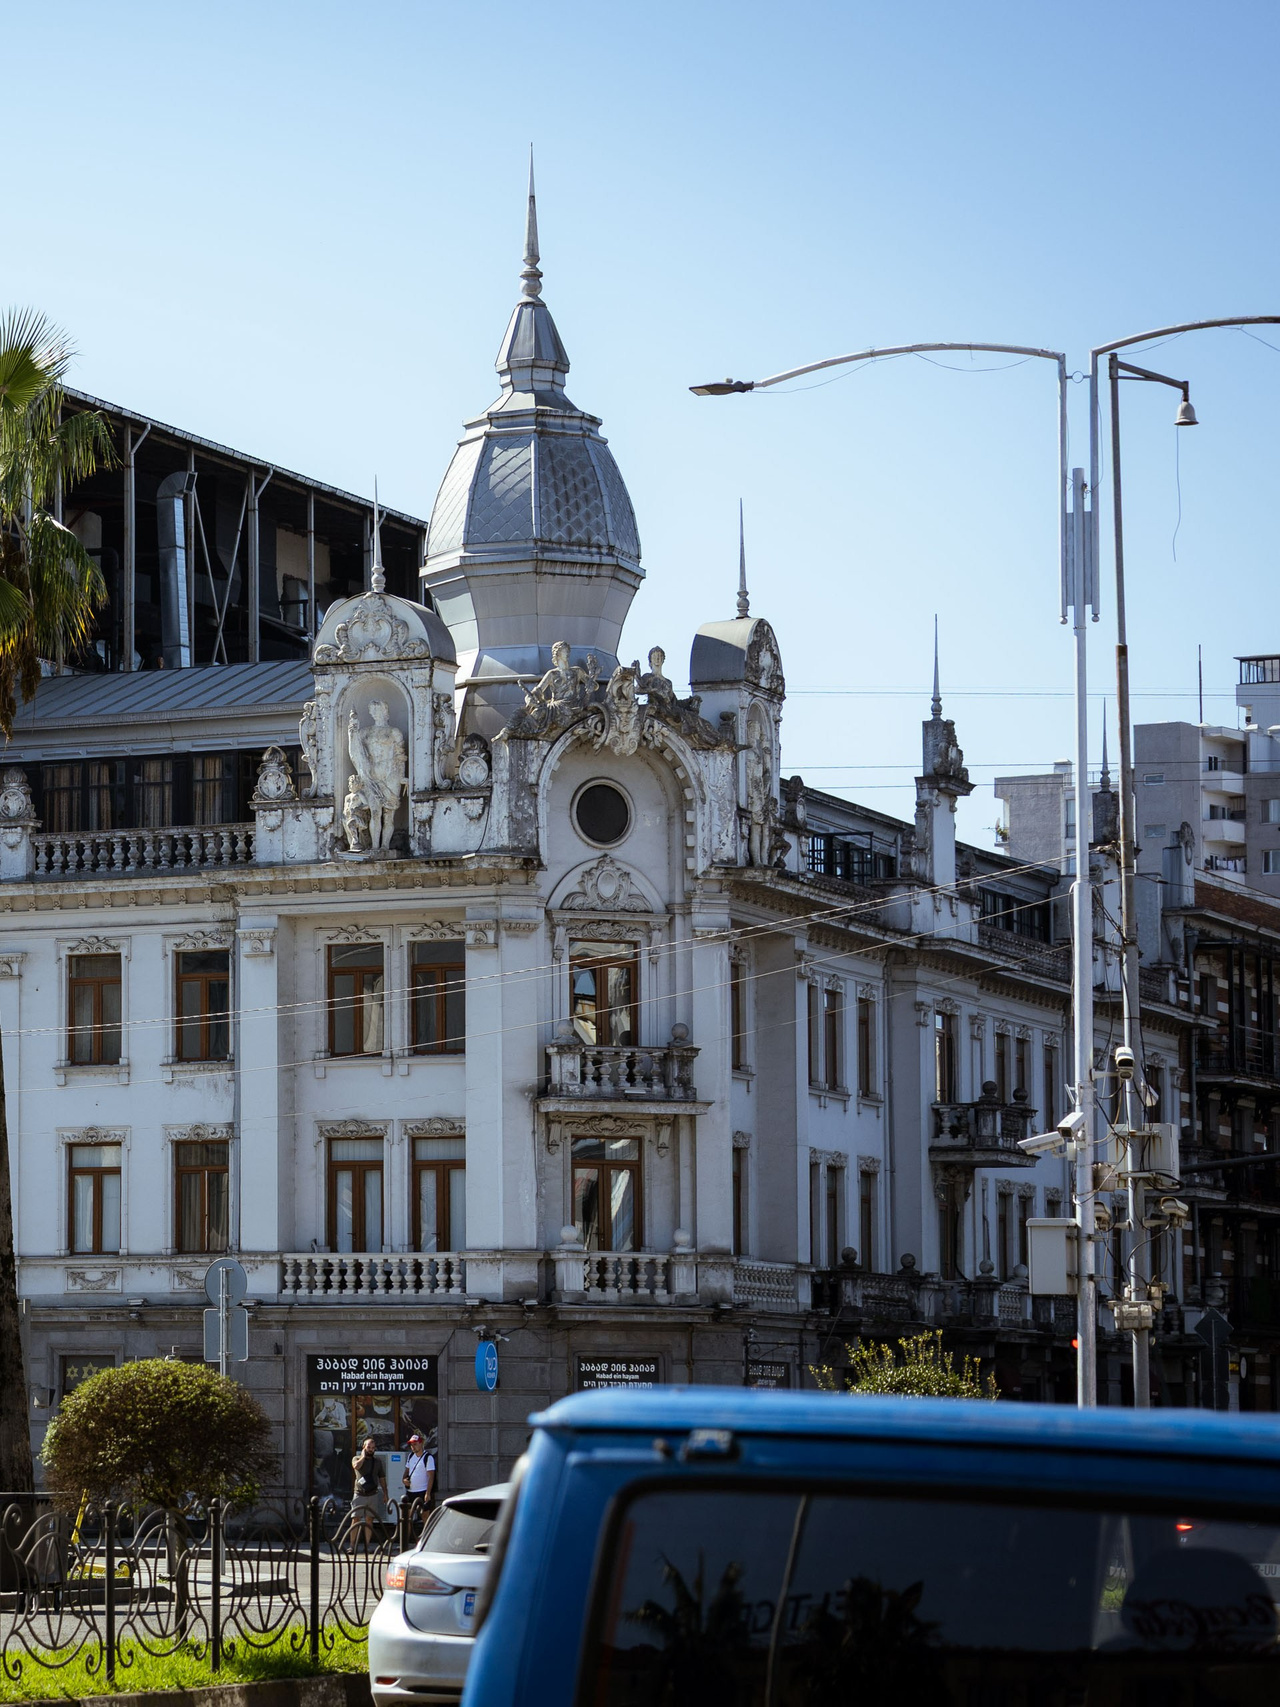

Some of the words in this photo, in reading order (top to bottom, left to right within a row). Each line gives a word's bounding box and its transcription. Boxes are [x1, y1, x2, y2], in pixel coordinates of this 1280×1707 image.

[316, 1358, 359, 1370] ჰაბად
[362, 1358, 386, 1370] ეინ
[389, 1358, 429, 1370] ჰაიამ
[580, 1362, 609, 1372] ჰაბად
[610, 1363, 627, 1372] ეინ
[628, 1363, 656, 1373] ჰაიამ
[341, 1371, 365, 1380] Habad
[366, 1371, 378, 1380] ein
[379, 1371, 404, 1381] hayam
[320, 1381, 339, 1391] הים
[342, 1381, 357, 1393] עין
[388, 1381, 425, 1391] מסעדת
